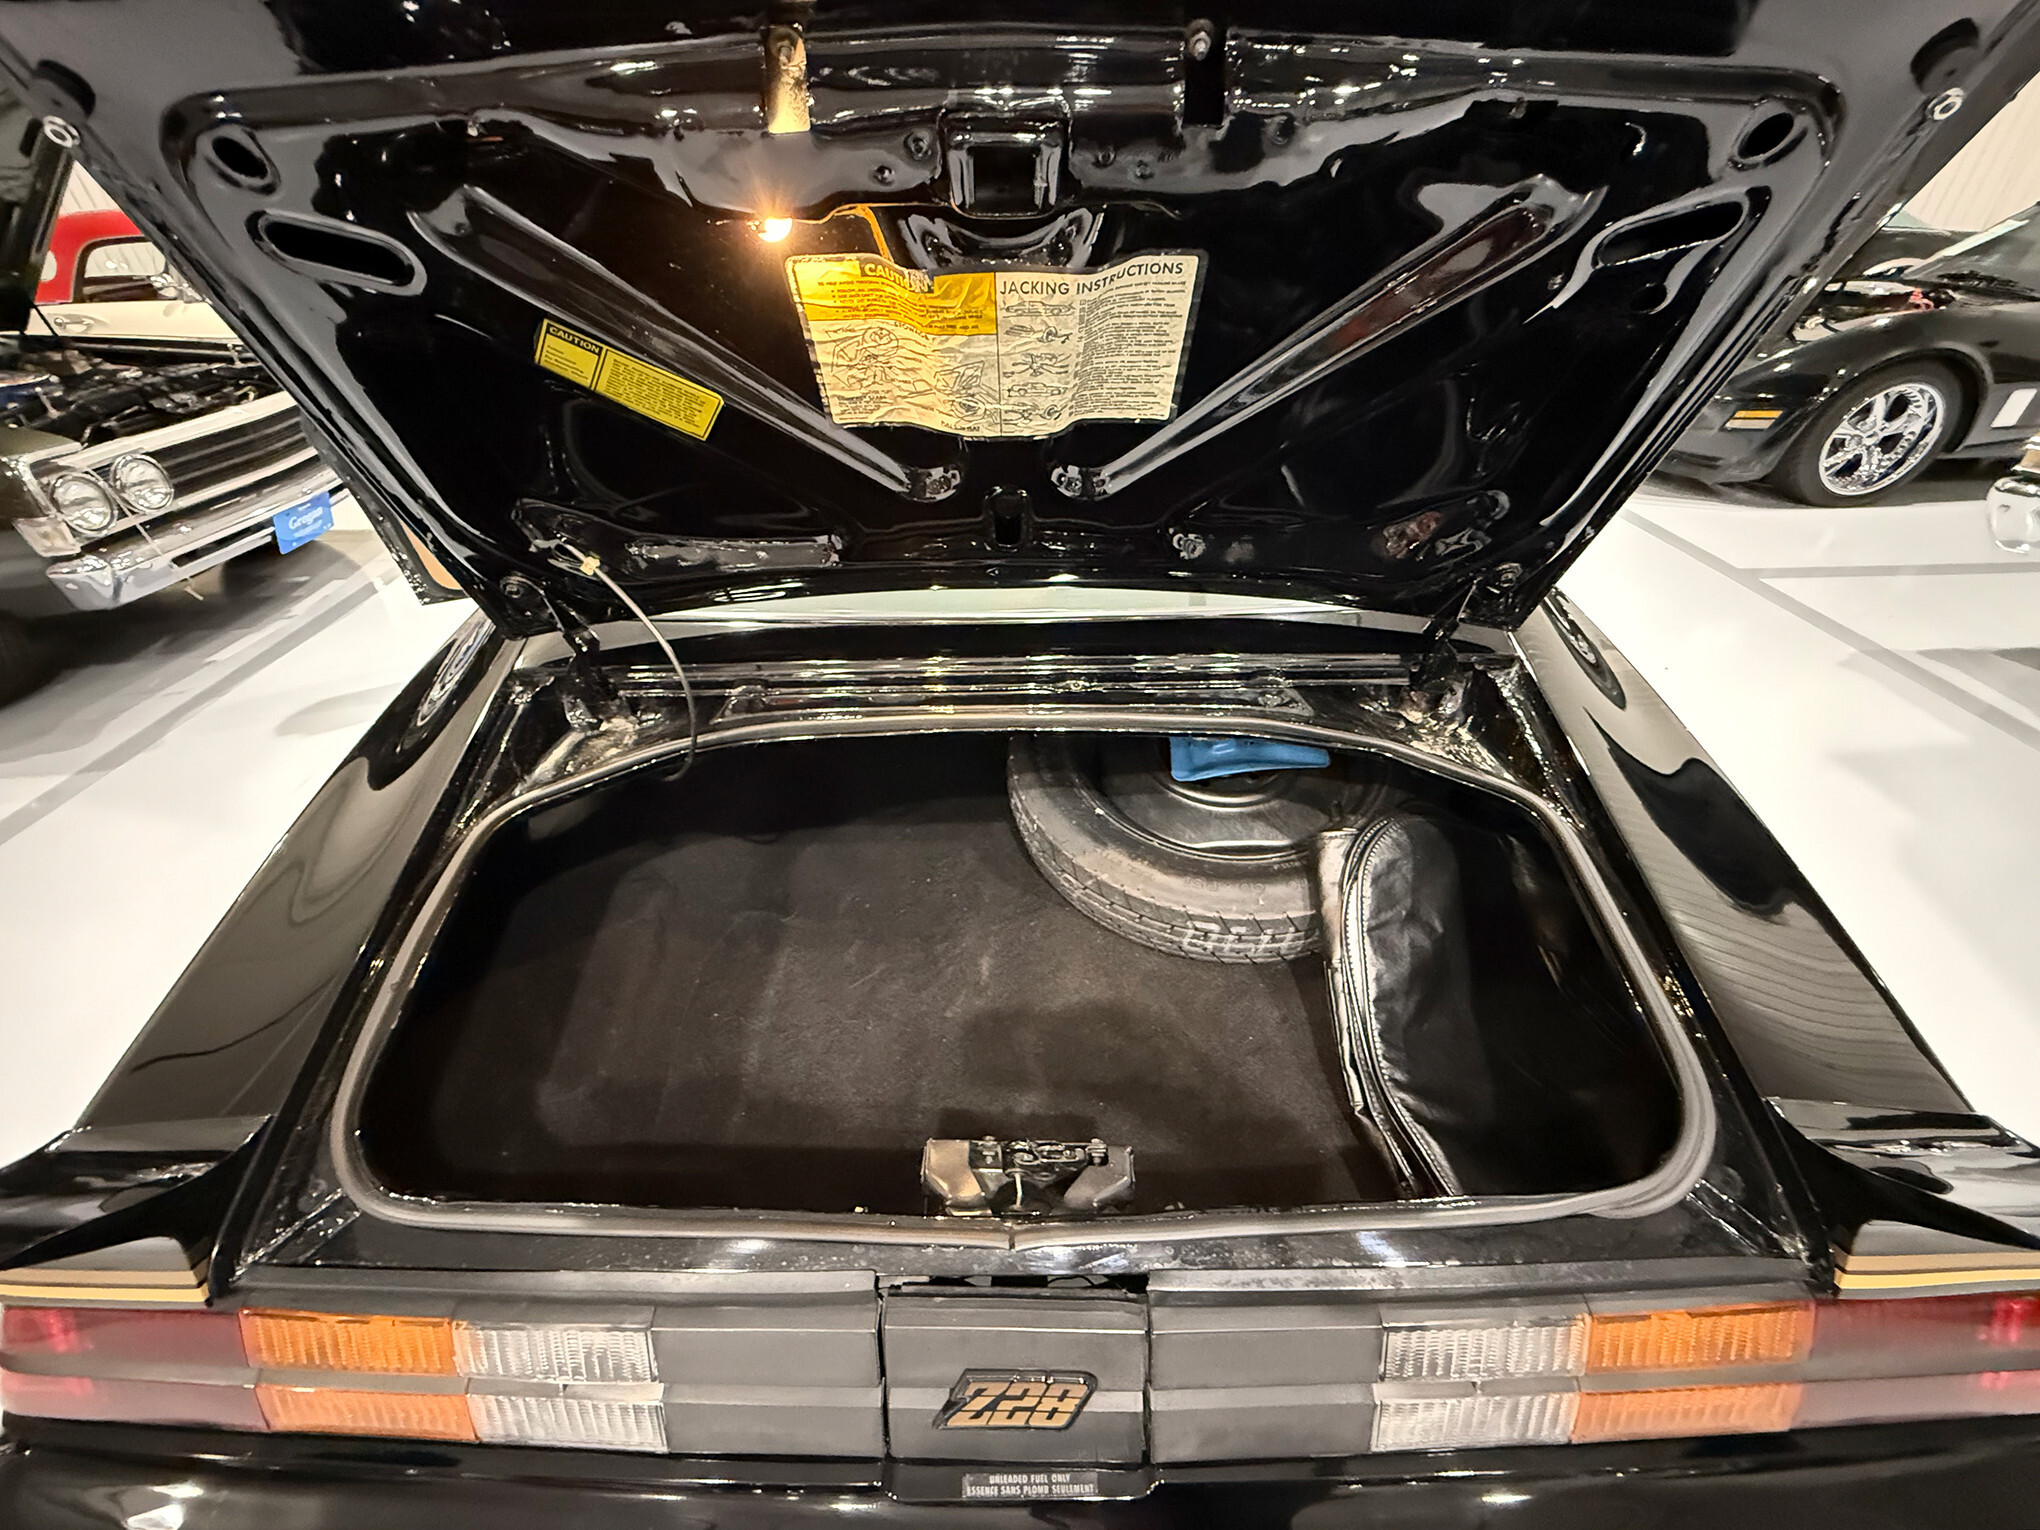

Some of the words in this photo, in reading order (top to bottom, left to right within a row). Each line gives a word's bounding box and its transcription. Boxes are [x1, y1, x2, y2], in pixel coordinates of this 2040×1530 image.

[863, 263, 933, 293] CAUTION
[999, 280, 1069, 295] JACKING
[1075, 262, 1184, 295] INSTRUCTIONS
[549, 326, 600, 354] CAUTION
[944, 1377, 1090, 1429] Z28
[966, 1485, 999, 1497] ESSENCE
[1000, 1485, 1021, 1496] SANS
[1023, 1484, 1050, 1495] PLOMB
[1051, 1483, 1095, 1494] SEULEMENT
[989, 1473, 1028, 1485] UNLEADED
[1030, 1473, 1049, 1484] FUEL
[1051, 1472, 1071, 1483] ONLY
